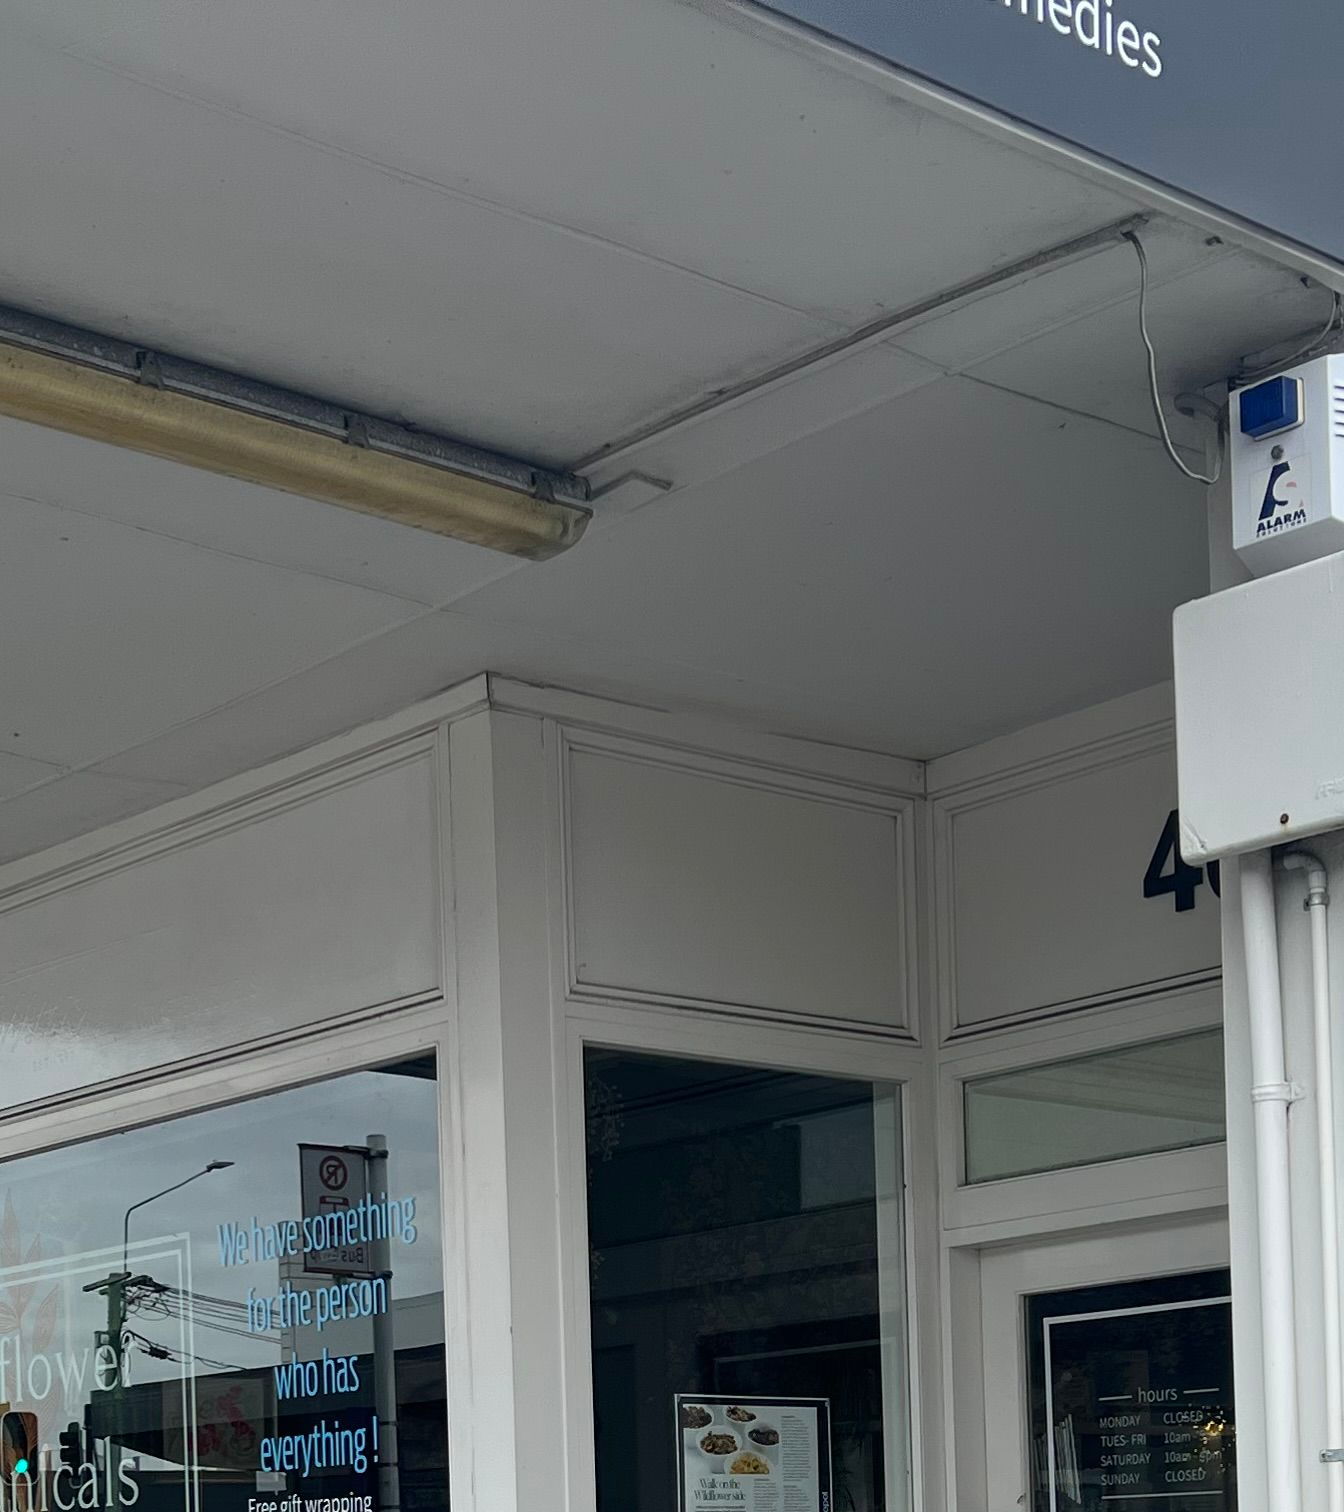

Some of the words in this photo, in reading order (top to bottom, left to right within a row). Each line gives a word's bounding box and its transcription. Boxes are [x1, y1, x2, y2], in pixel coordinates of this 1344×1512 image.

[1257, 509, 1306, 533] ALARM
[1143, 808, 1221, 912] 4
[217, 1221, 248, 1267] We
[251, 1216, 298, 1262] have
[303, 1192, 416, 1253] something
[247, 1288, 274, 1332] for
[280, 1281, 311, 1328] the
[317, 1277, 388, 1331] person
[274, 1352, 318, 1400] who
[323, 1348, 360, 1394] has
[1138, 1387, 1178, 1403] hours
[1099, 1415, 1140, 1428] MONDAY
[1163, 1411, 1204, 1425] CLOSED
[1164, 1432, 1191, 1443] 10am
[260, 1420, 367, 1478] everything
[1100, 1453, 1151, 1467] SATURDAY
[1100, 1474, 1140, 1486] SUNDAY
[1165, 1468, 1206, 1482] CLOSED
[694, 1490, 731, 1501] Wildflower
